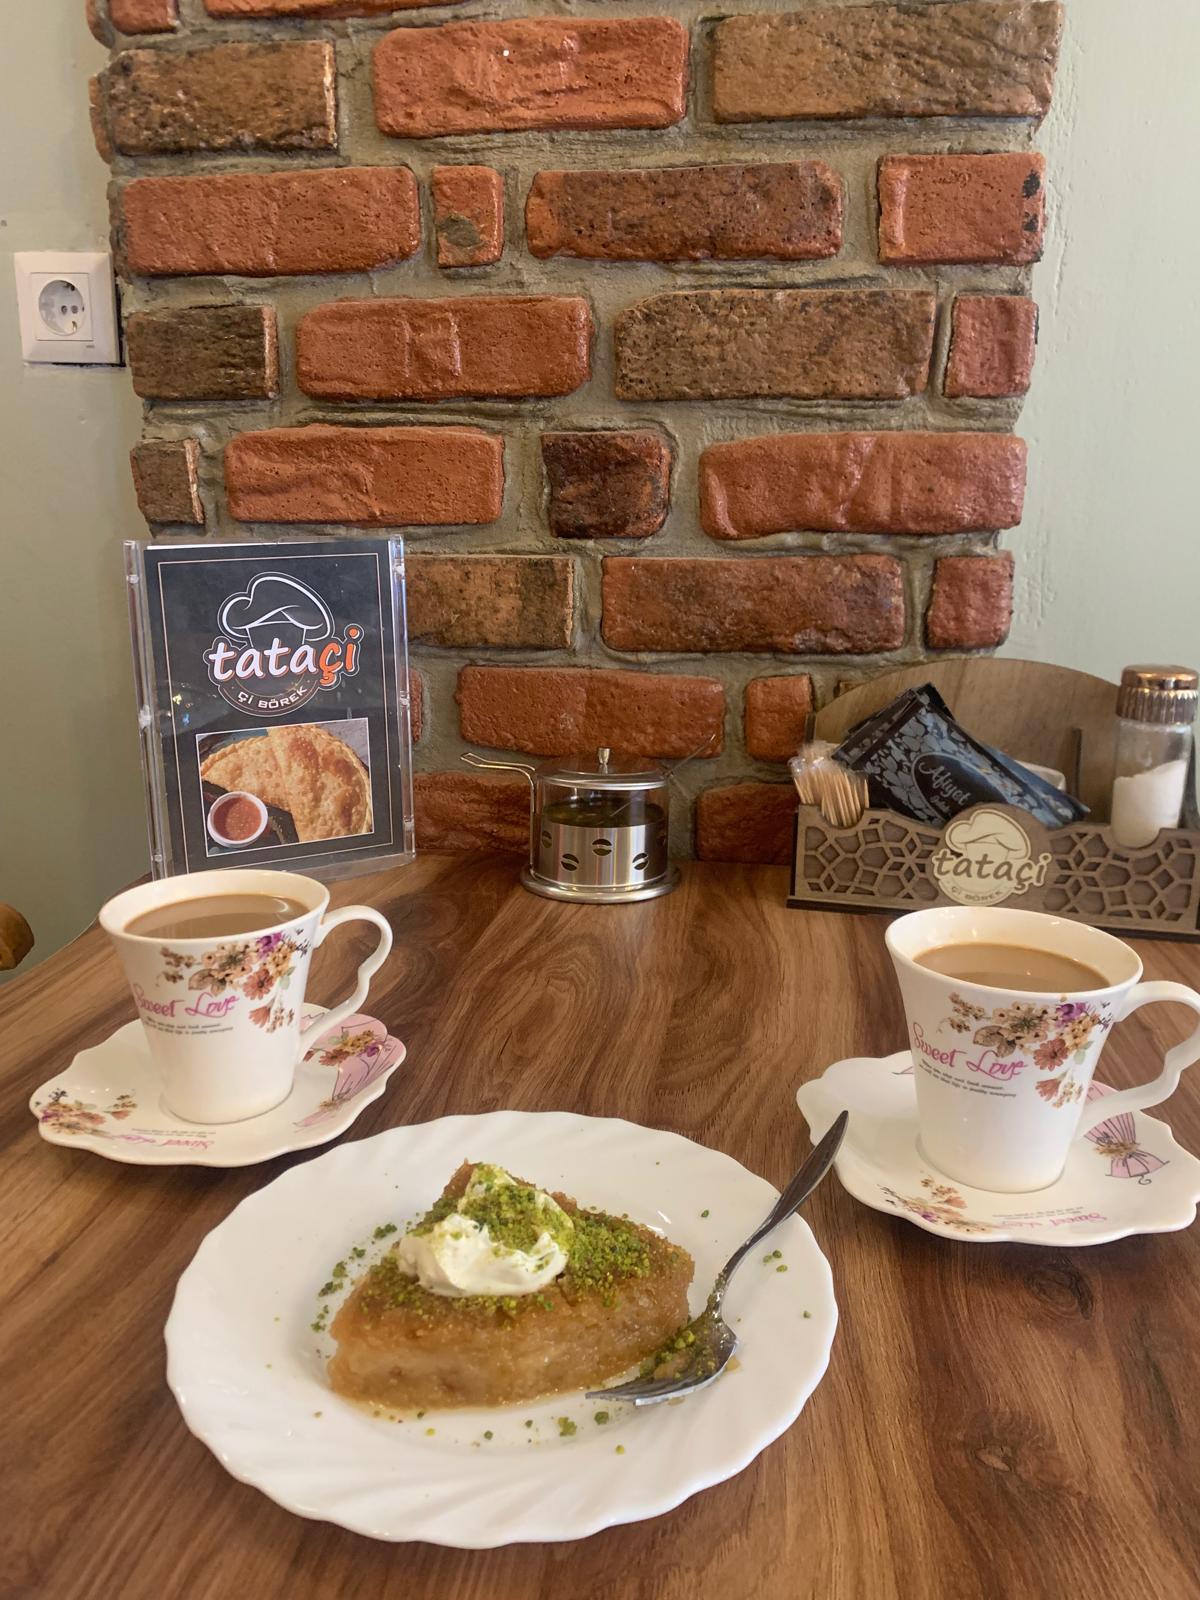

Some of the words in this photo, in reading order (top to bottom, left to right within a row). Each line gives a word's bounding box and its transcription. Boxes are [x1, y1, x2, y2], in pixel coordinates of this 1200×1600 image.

[208, 628, 360, 686] tataçi
[257, 685, 308, 709] BÖREK
[918, 762, 972, 806] Afiyet
[935, 850, 1050, 891] tataçi
[184, 991, 240, 1019] Love
[912, 1022, 967, 1068] Sweet
[966, 1049, 1029, 1082] Love
